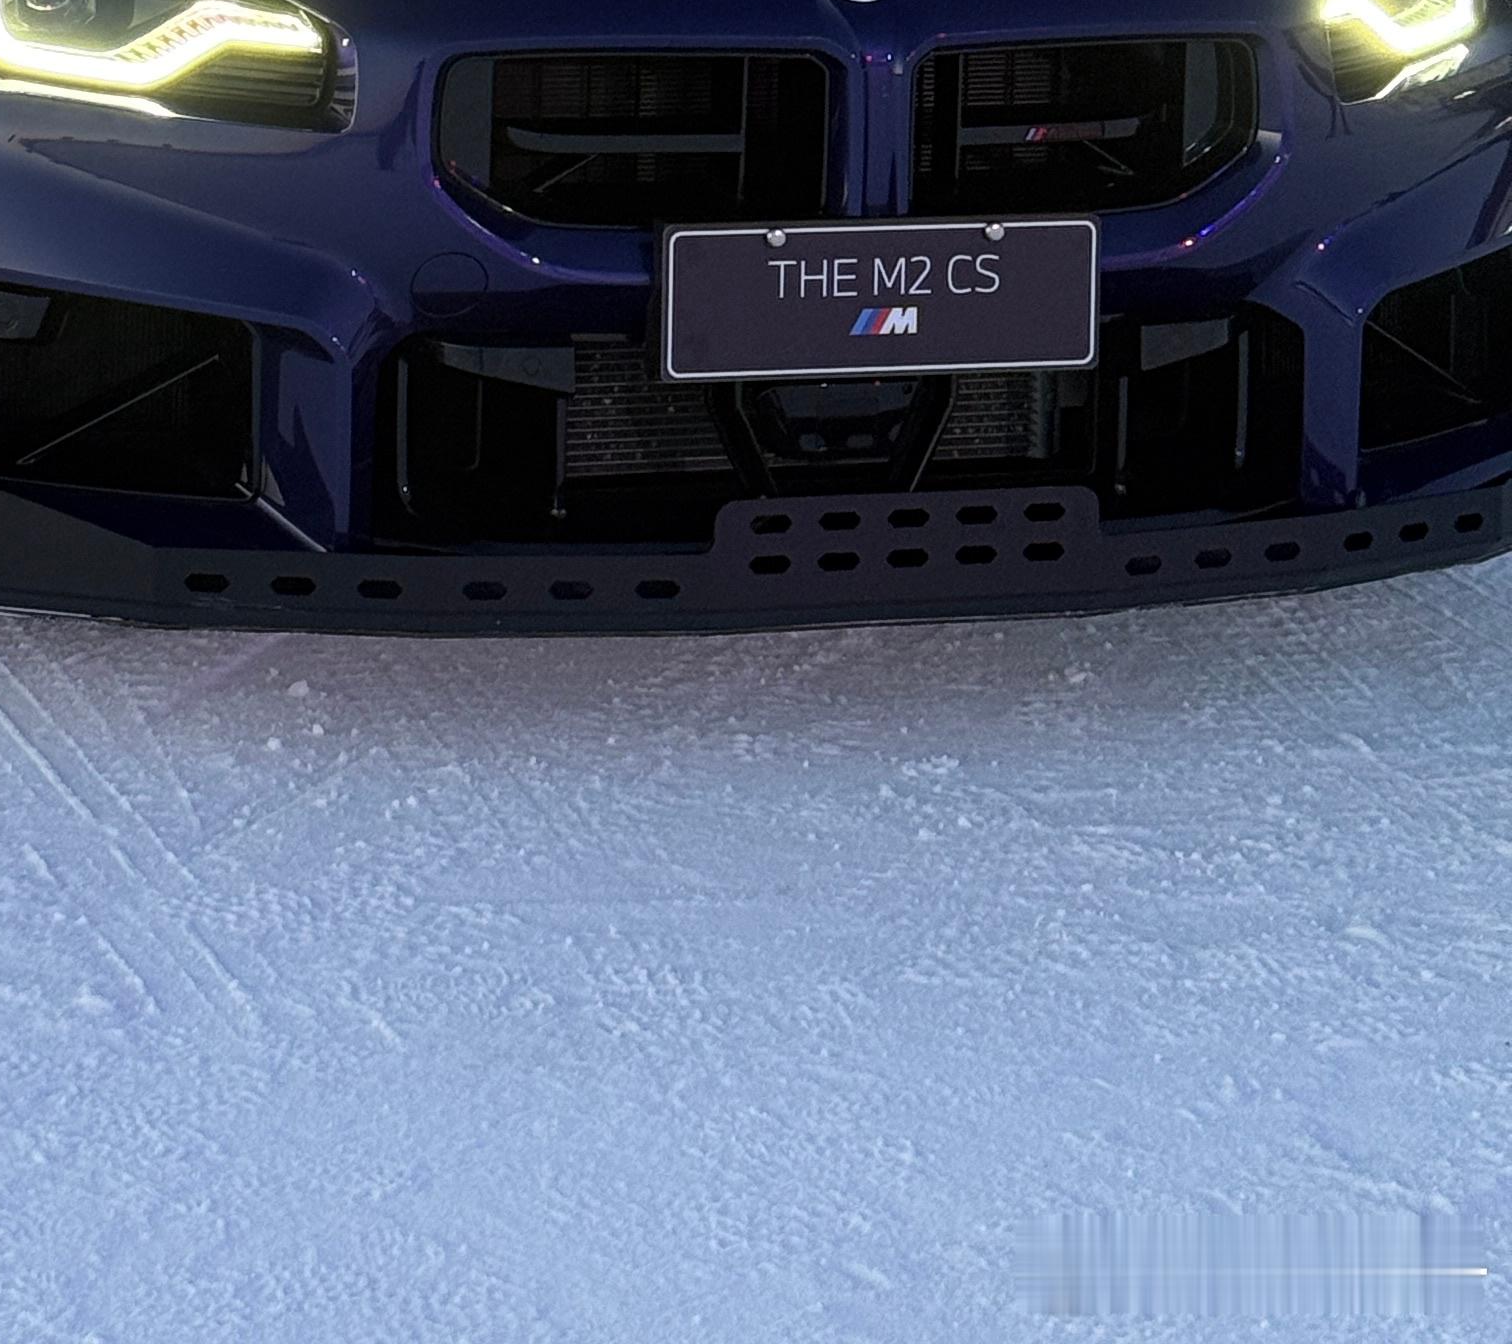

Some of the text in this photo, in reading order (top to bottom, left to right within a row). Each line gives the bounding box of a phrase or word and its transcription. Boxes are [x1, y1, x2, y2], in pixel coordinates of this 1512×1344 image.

[767, 254, 1001, 299] THE M2 CS
[876, 306, 918, 335] M
